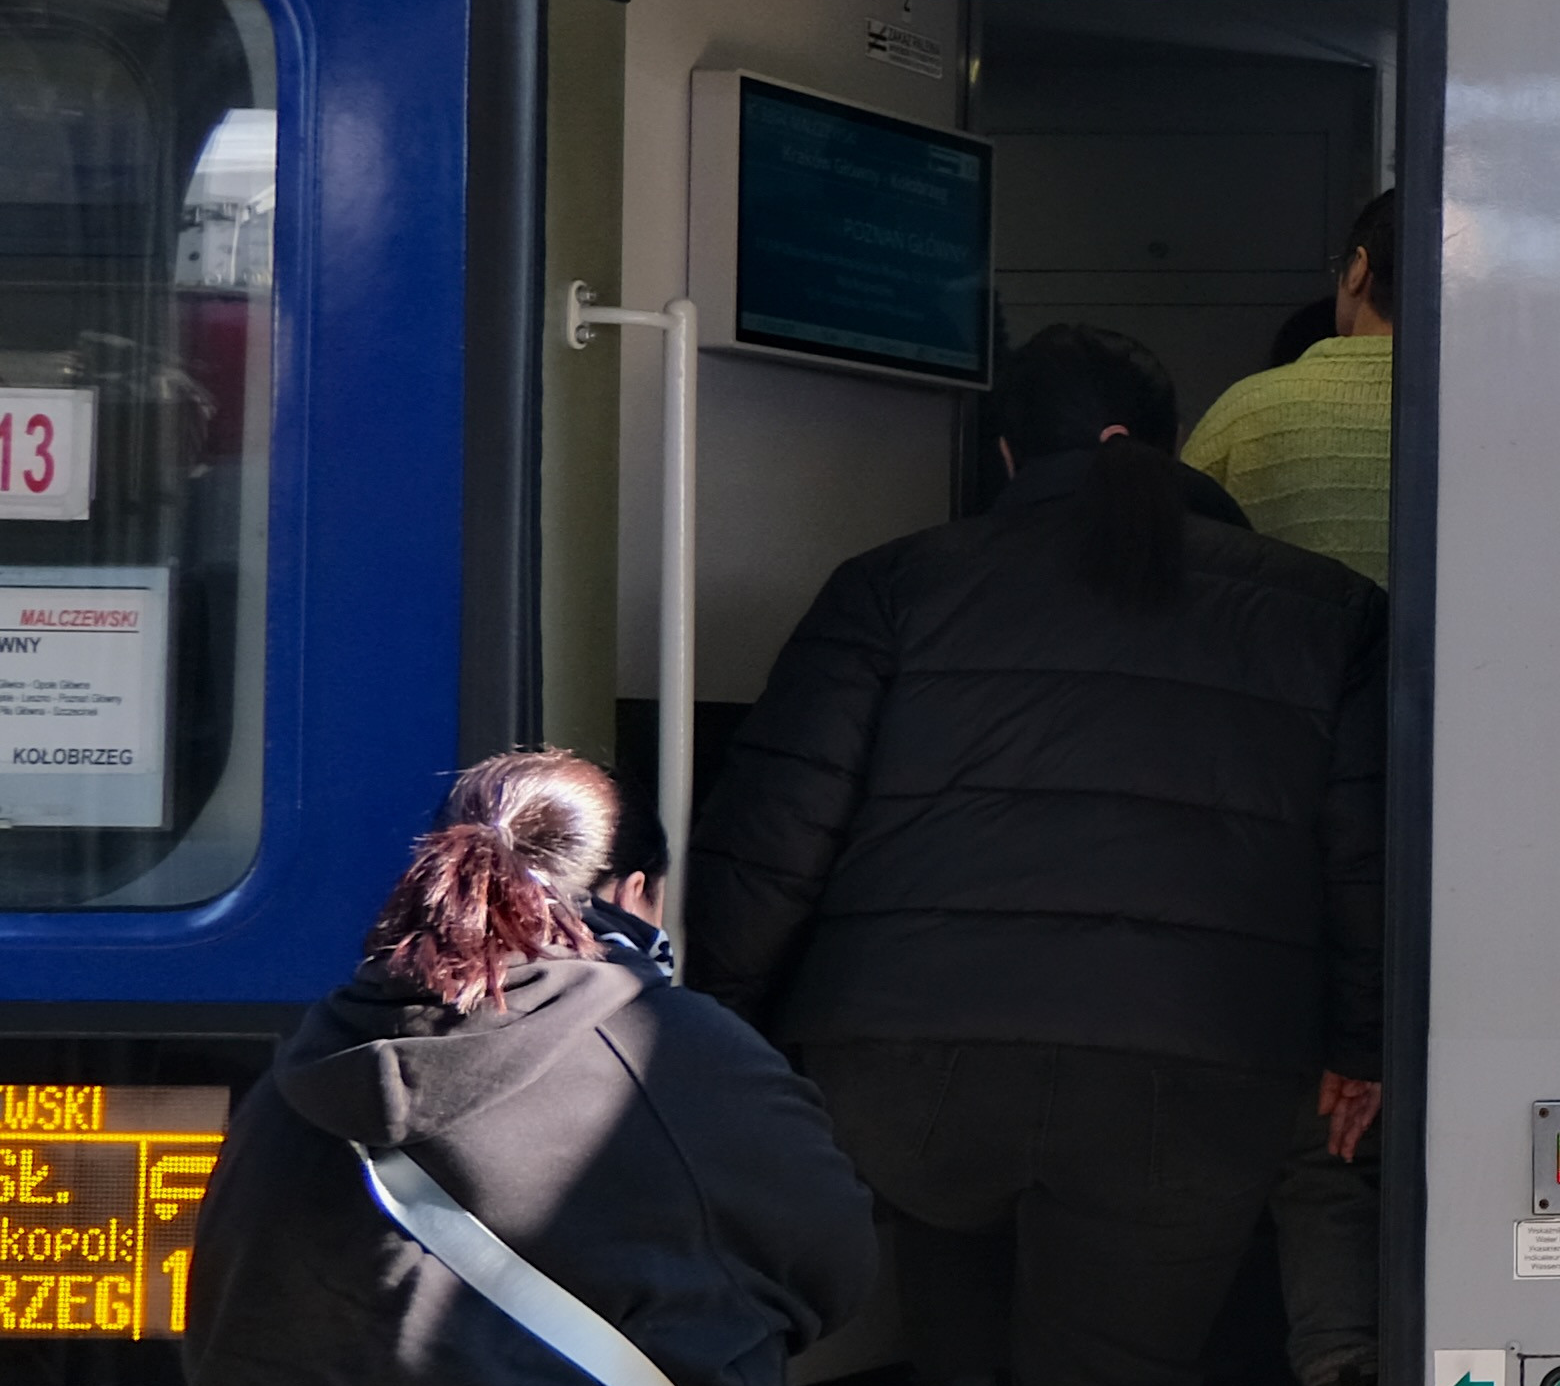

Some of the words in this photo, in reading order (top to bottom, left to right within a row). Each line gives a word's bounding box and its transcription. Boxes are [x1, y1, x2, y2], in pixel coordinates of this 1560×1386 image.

[0, 413, 55, 494] 13
[20, 609, 139, 628] MALCZEWSKI
[13, 747, 134, 765] KOŁOBRZEG
[0, 1085, 103, 1131] WSKI
